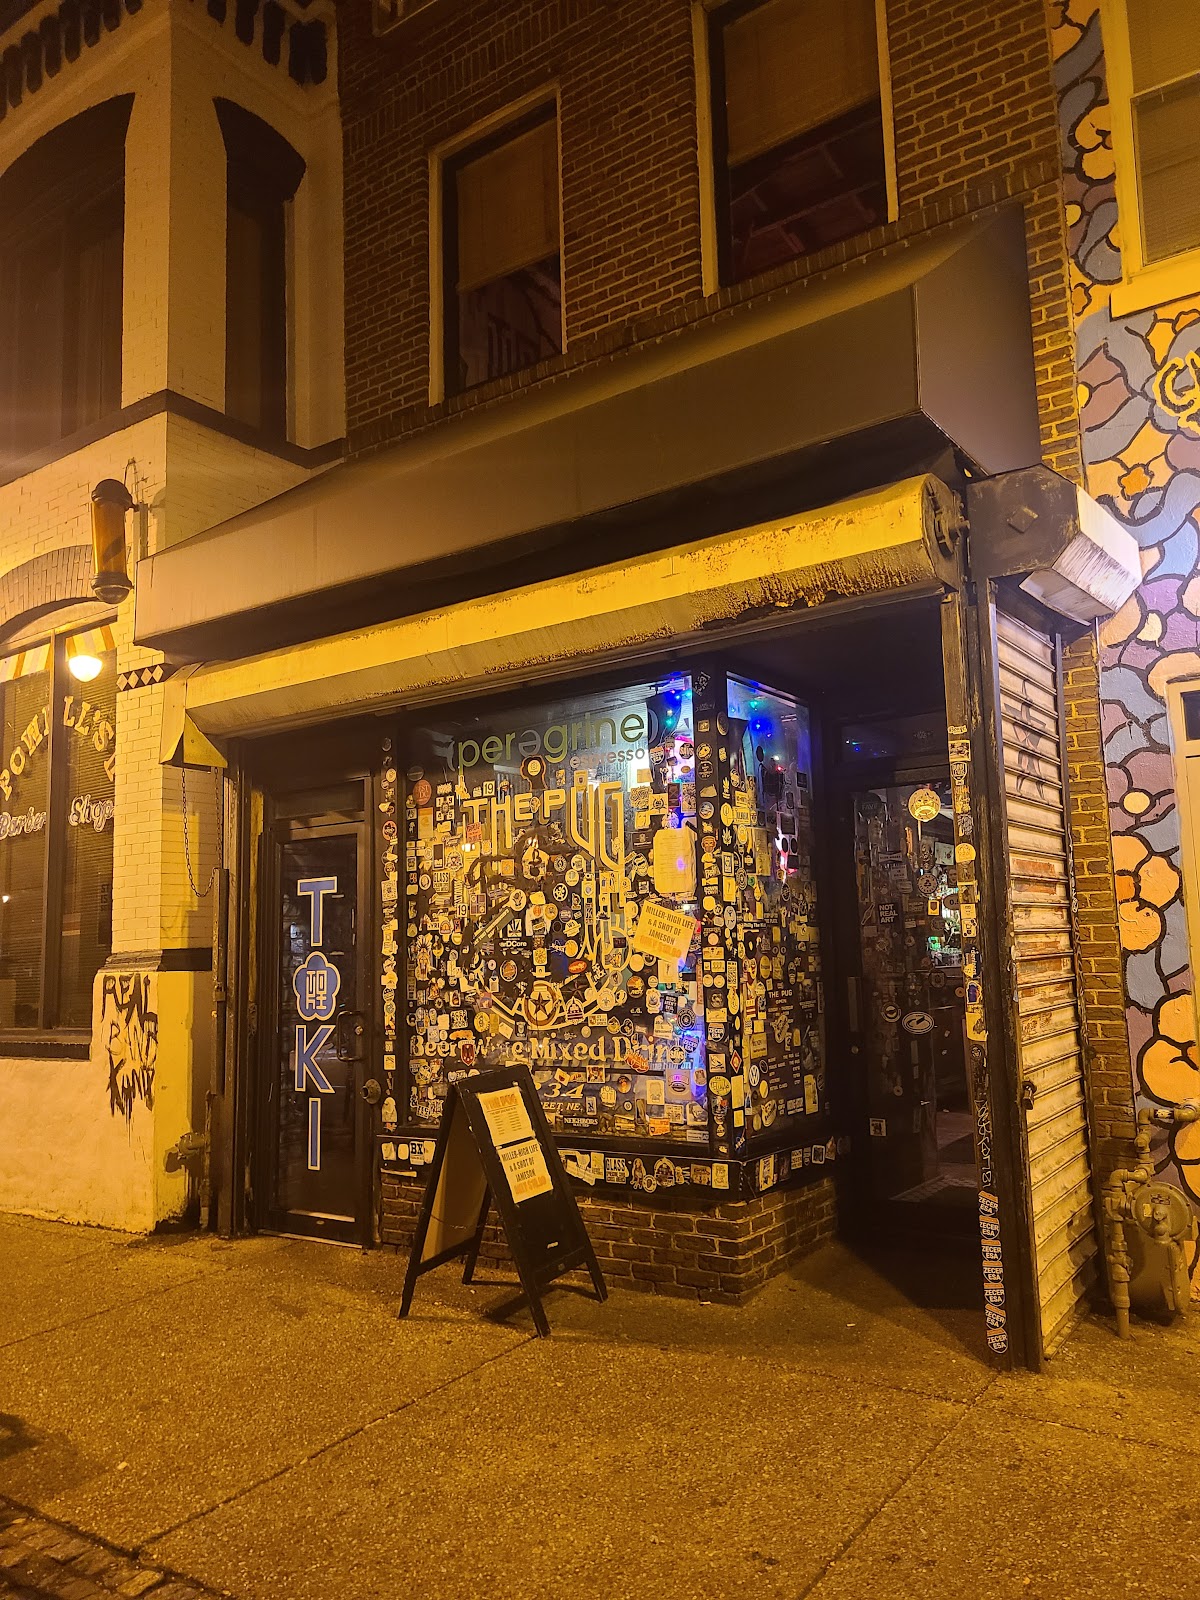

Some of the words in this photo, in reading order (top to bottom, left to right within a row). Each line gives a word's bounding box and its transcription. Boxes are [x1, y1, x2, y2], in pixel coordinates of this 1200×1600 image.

[570, 748, 645, 769] espresso
[484, 783, 494, 794] 19
[0, 807, 46, 840] Barber
[463, 792, 533, 856] THE
[458, 905, 467, 916] 19
[648, 929, 676, 946] JAMESON
[529, 1036, 606, 1061] Mixed
[978, 1196, 998, 1208] ZECER
[980, 1203, 993, 1213] ESA
[979, 1222, 999, 1230] ZECER
[981, 1245, 1002, 1253] ZECER
[989, 1295, 1002, 1303] ESA
[985, 1309, 1005, 1323] ZECER
[986, 1316, 999, 1327] ESA
[987, 1334, 1007, 1344] ZECER
[993, 1341, 1006, 1350] ESA
